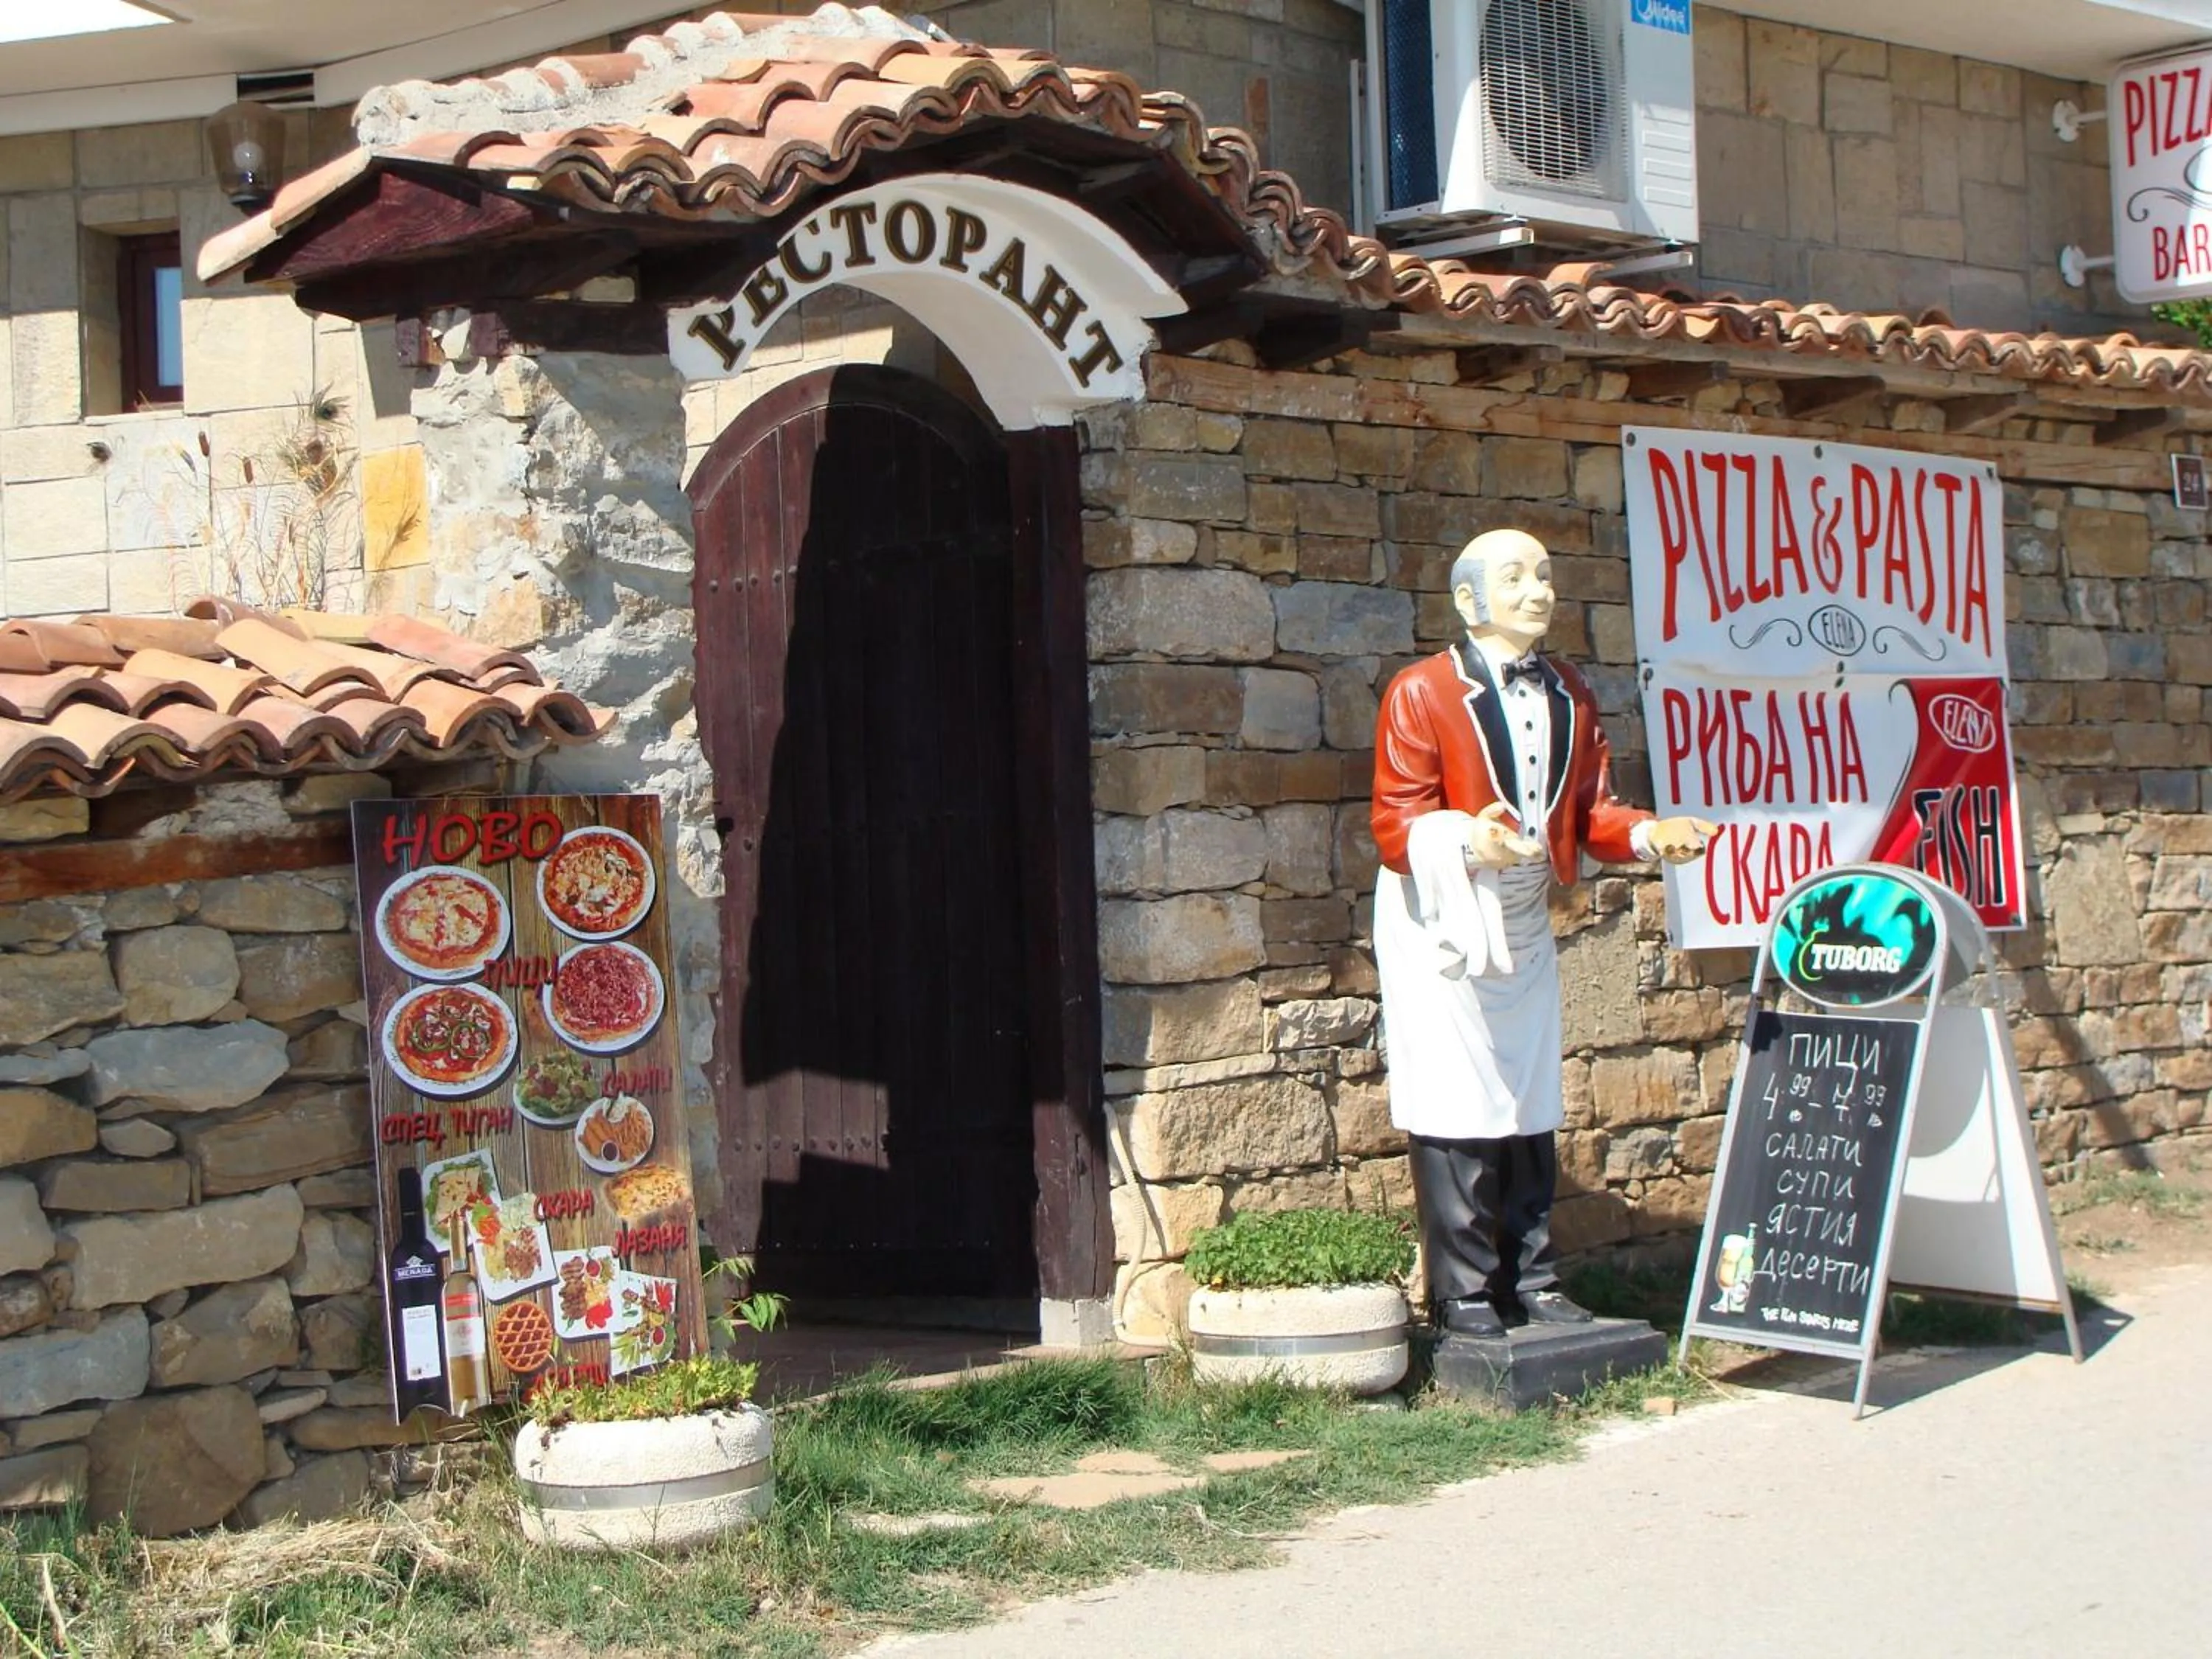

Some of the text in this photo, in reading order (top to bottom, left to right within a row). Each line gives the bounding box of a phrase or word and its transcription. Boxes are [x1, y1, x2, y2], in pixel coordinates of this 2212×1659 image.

[2124, 66, 2212, 167] PIZZ
[688, 199, 1124, 388] РЕСТОРАНТ
[1648, 447, 1992, 658] PIZZA & PASTA
[1663, 687, 1868, 806] РИБА НА
[383, 811, 563, 868] НОВО
[1911, 784, 2006, 908] FISH
[1811, 943, 1903, 973] TUBORG
[1789, 1033, 1880, 1081] ПИЦИ
[1766, 1132, 1863, 1167] САЛАТИ
[533, 1188, 595, 1222] СКАРА
[1777, 1169, 1855, 1199] СУПИ
[612, 1224, 687, 1258] ЛАЗАНЯ
[1766, 1203, 1858, 1248] ЯСТИЯ
